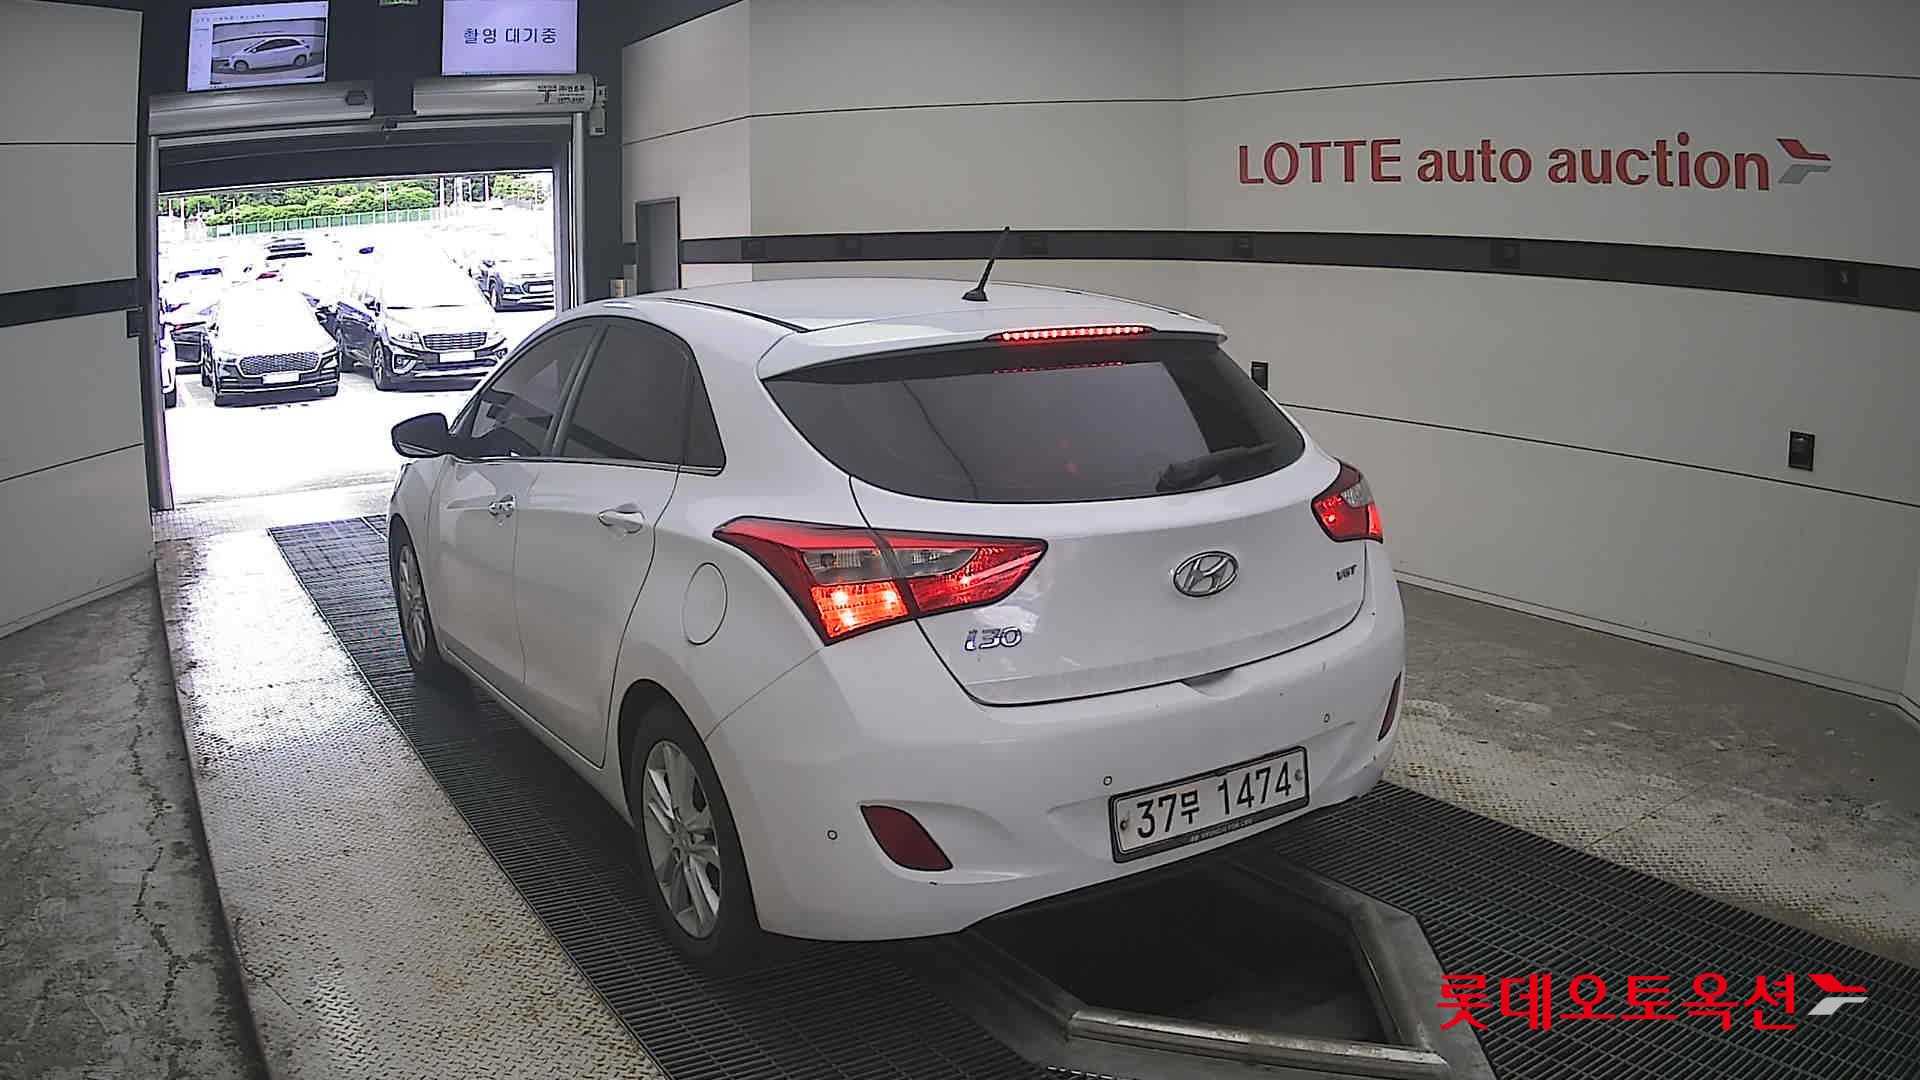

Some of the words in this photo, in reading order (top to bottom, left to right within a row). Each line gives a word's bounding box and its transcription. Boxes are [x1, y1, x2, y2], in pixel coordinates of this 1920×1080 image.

[464, 27, 497, 44] 촬영
[505, 27, 557, 44] 대기중
[1239, 138, 1401, 185] LOTTE
[1417, 139, 1532, 183] auto
[1548, 131, 1770, 191] auction
[964, 626, 1022, 651] i30
[1137, 789, 1200, 838] 37무
[1217, 761, 1292, 815] 1474
